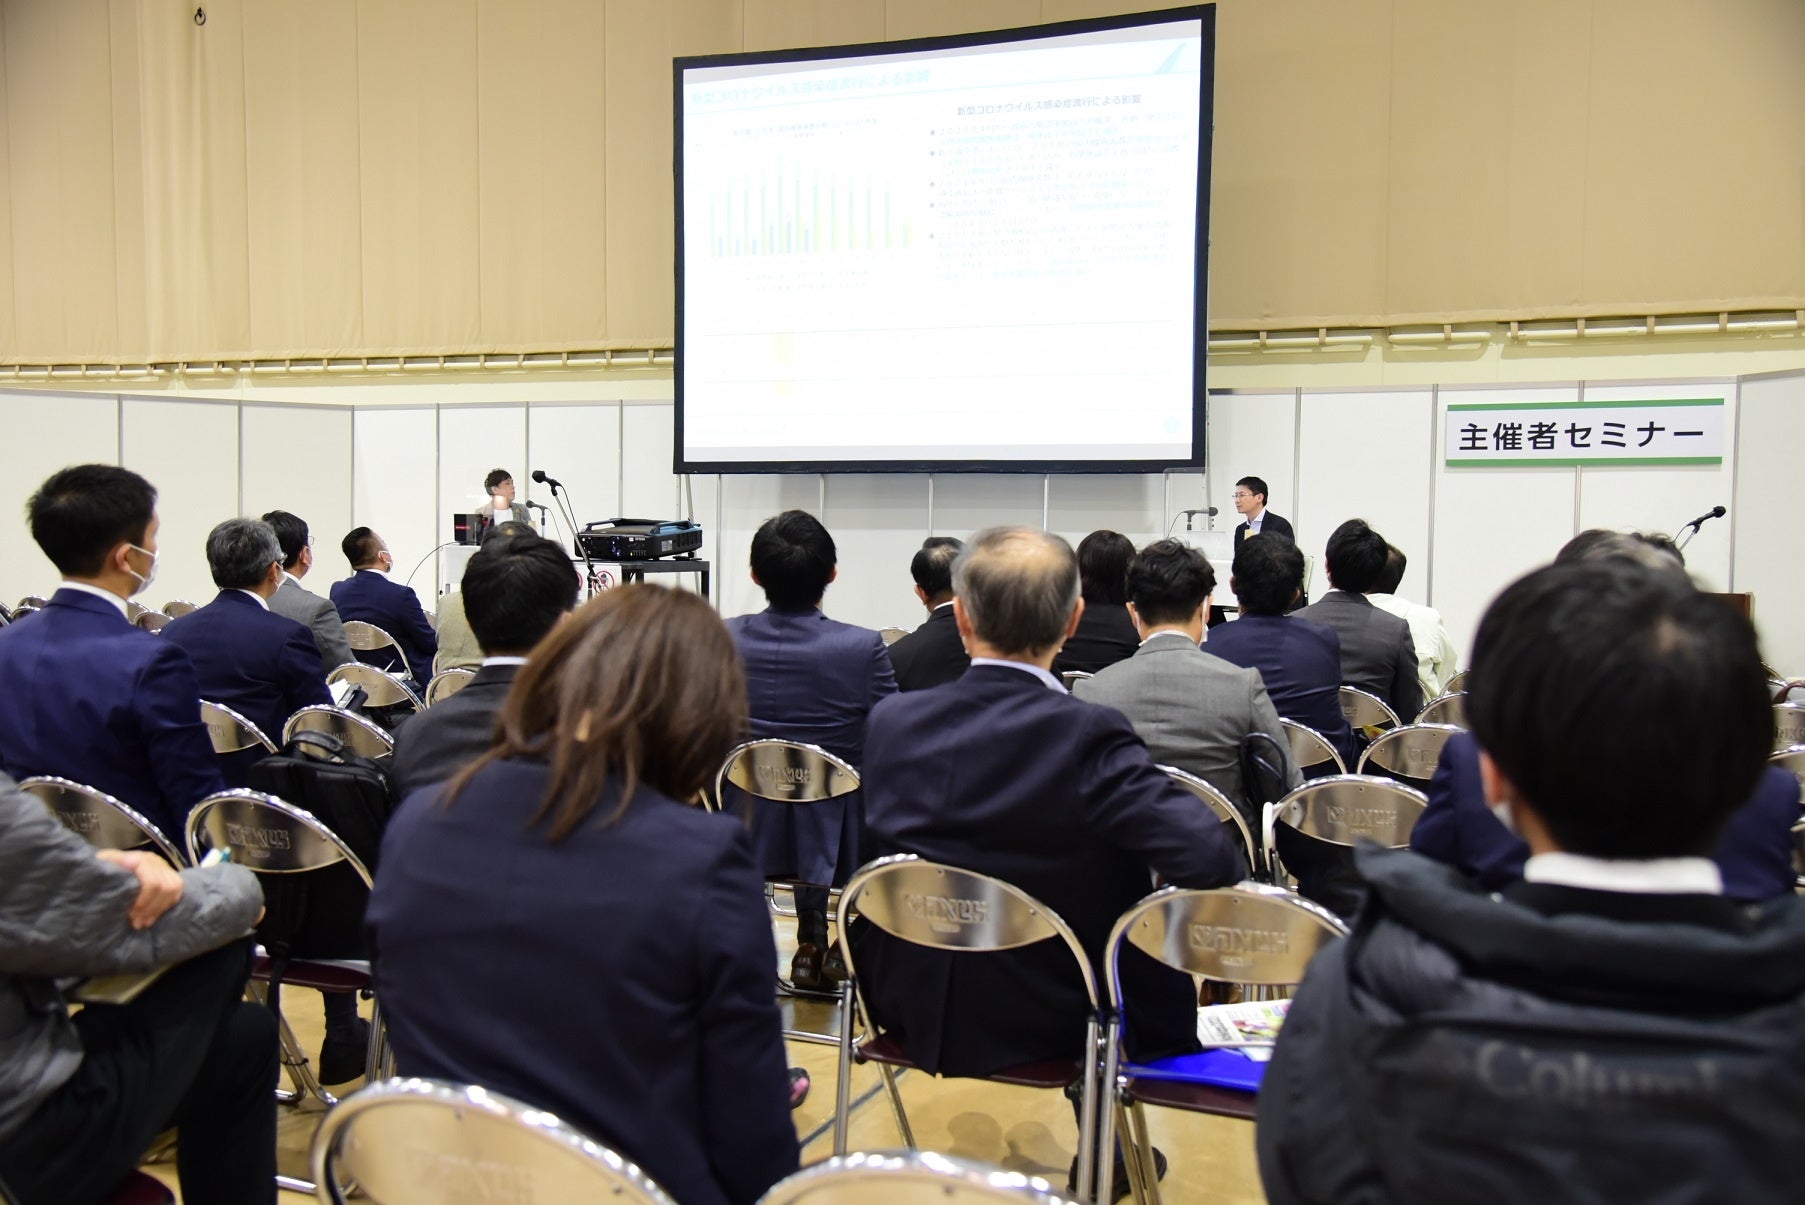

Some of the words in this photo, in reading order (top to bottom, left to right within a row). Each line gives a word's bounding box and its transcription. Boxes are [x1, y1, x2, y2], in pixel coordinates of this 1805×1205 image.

[1459, 421, 1704, 451] 主催者セミナー
